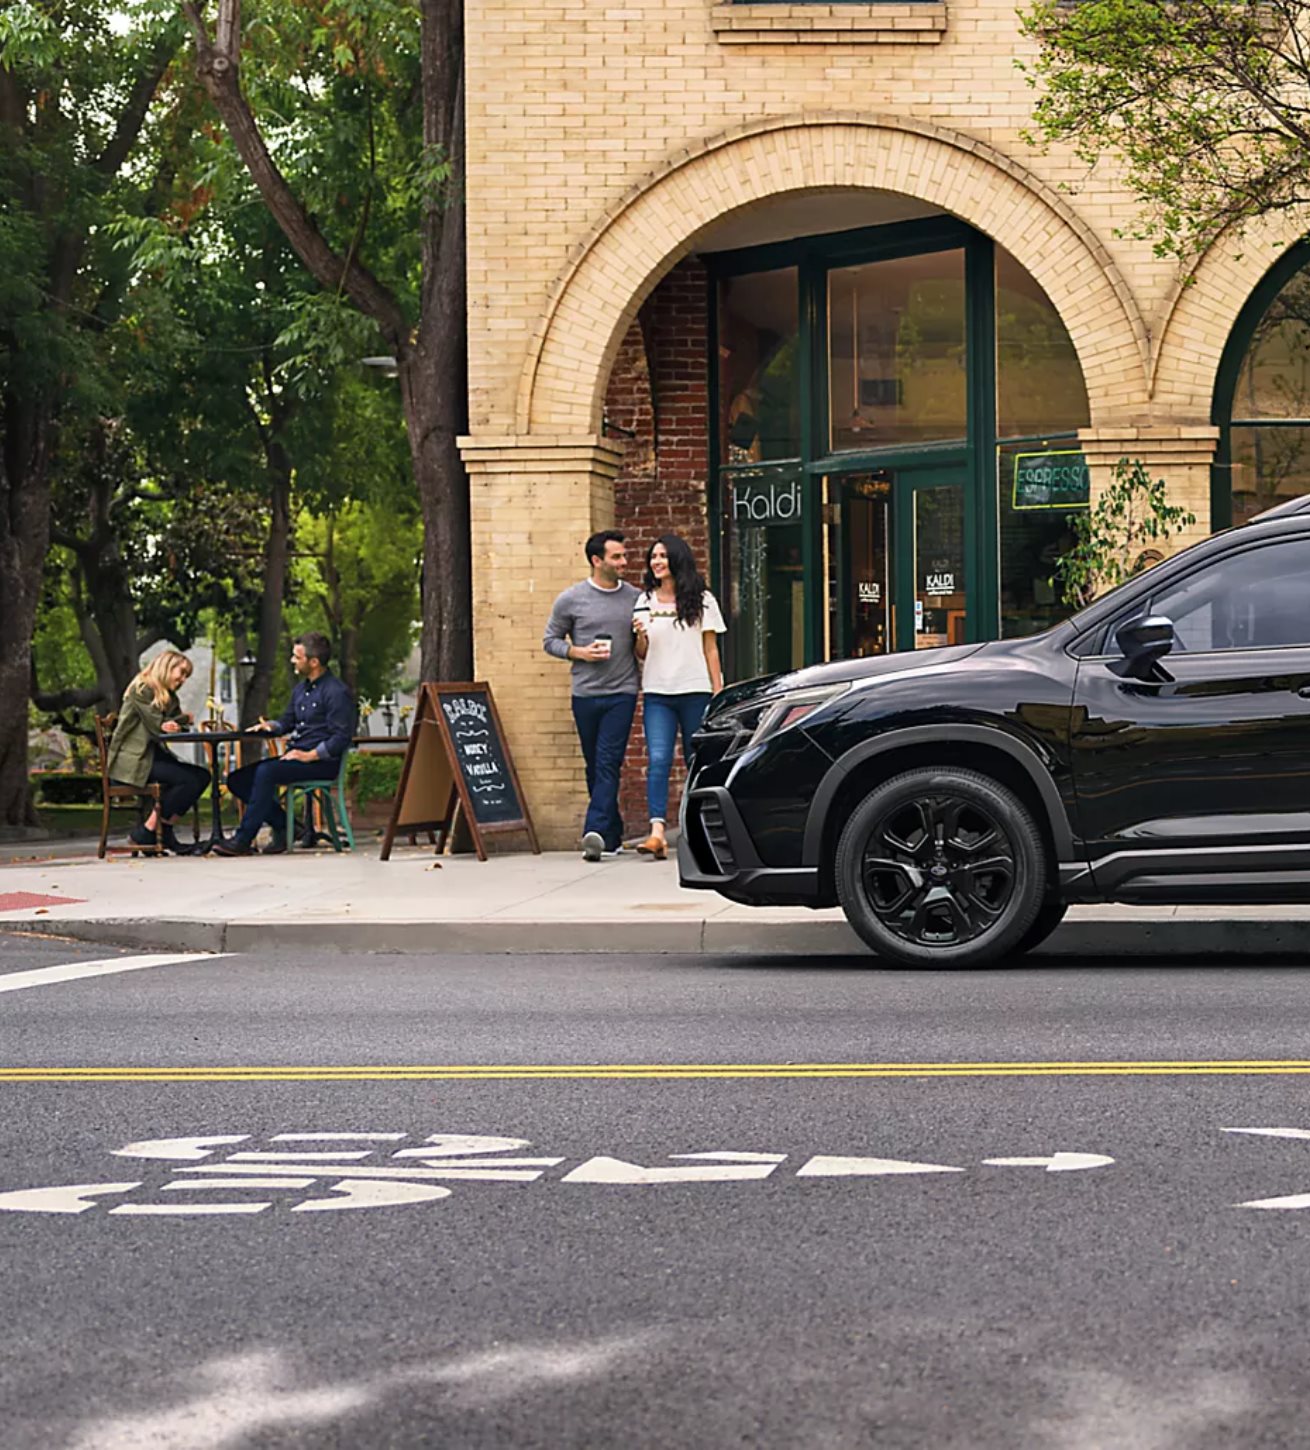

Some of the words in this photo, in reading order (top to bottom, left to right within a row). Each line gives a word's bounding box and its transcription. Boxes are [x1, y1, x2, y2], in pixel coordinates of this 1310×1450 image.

[733, 481, 801, 519] Kaldi
[926, 573, 954, 587] KALDI
[859, 582, 880, 595] KALDI
